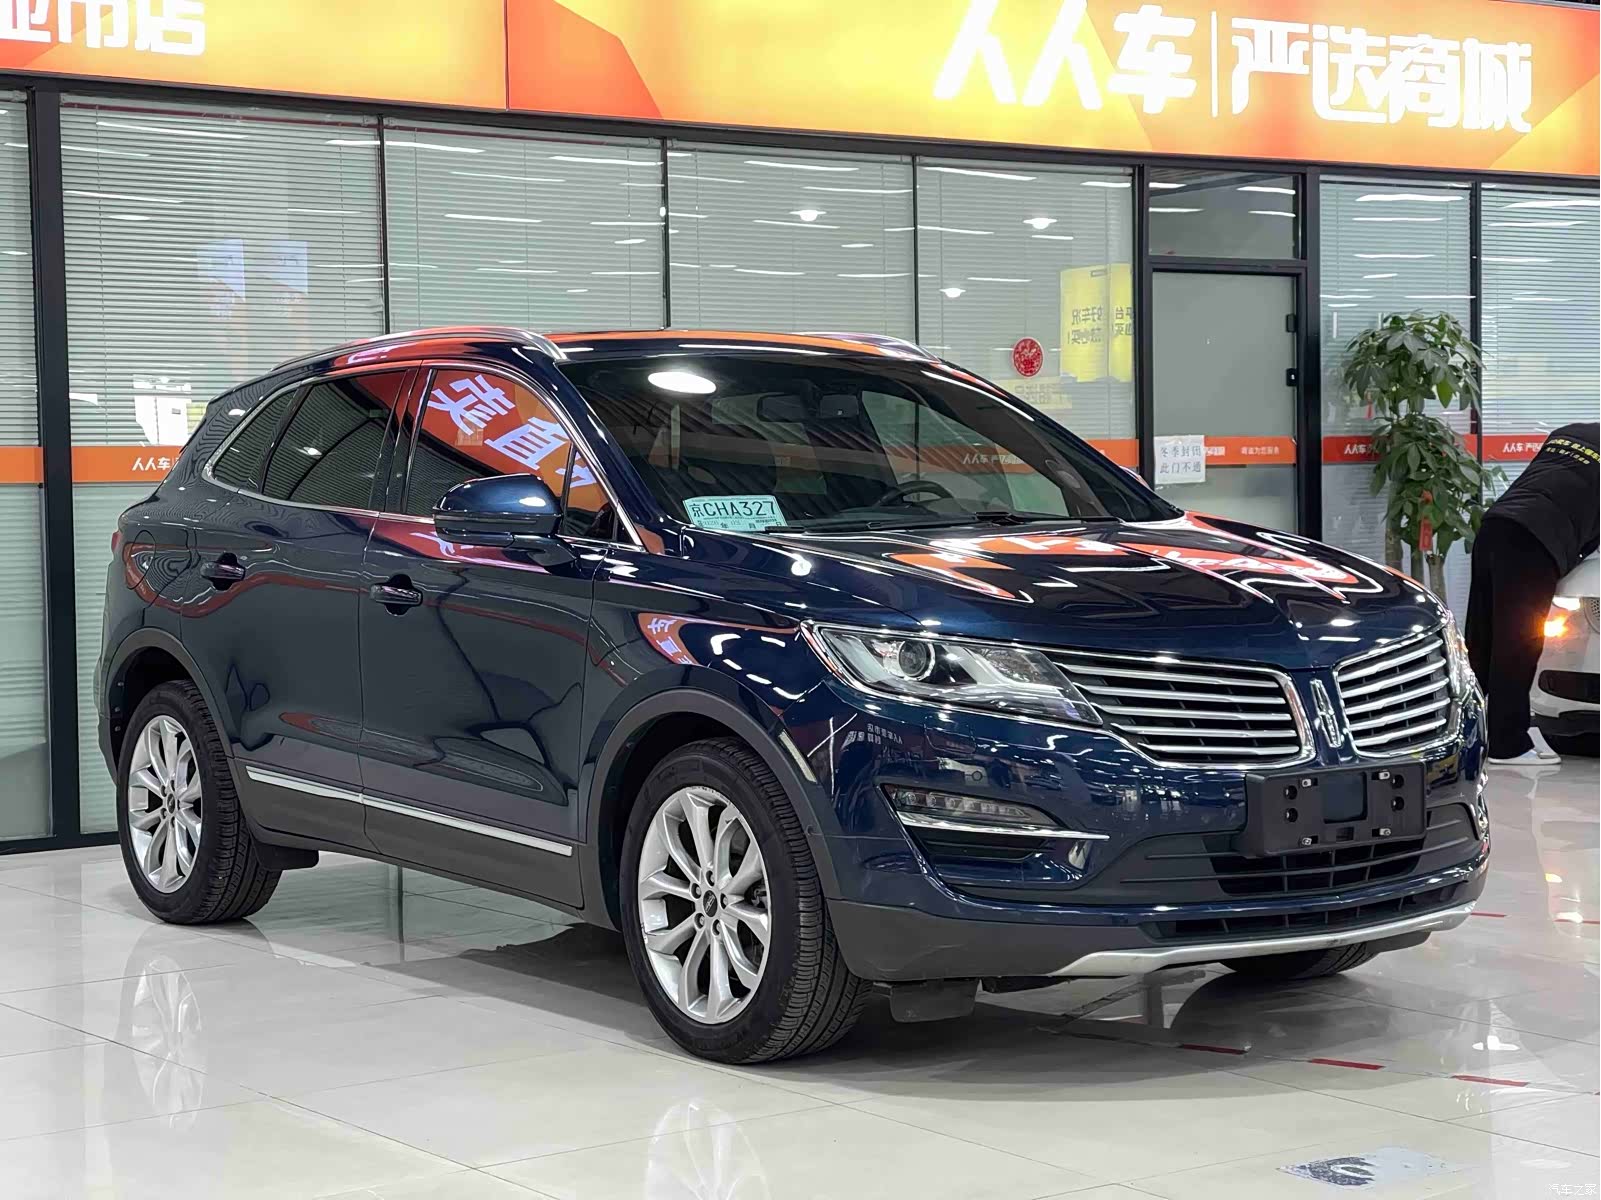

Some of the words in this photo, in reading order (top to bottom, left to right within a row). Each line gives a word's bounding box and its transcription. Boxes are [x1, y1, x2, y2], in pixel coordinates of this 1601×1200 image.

[932, 0, 1197, 114] 人人车
[1231, 17, 1532, 133] 严选商城
[1159, 445, 1202, 458] 冬季封闭
[1502, 442, 1524, 453] 人人车
[132, 457, 171, 471] 人人车
[1159, 460, 1202, 474] 此门不通
[689, 501, 776, 517] 京CHA327
